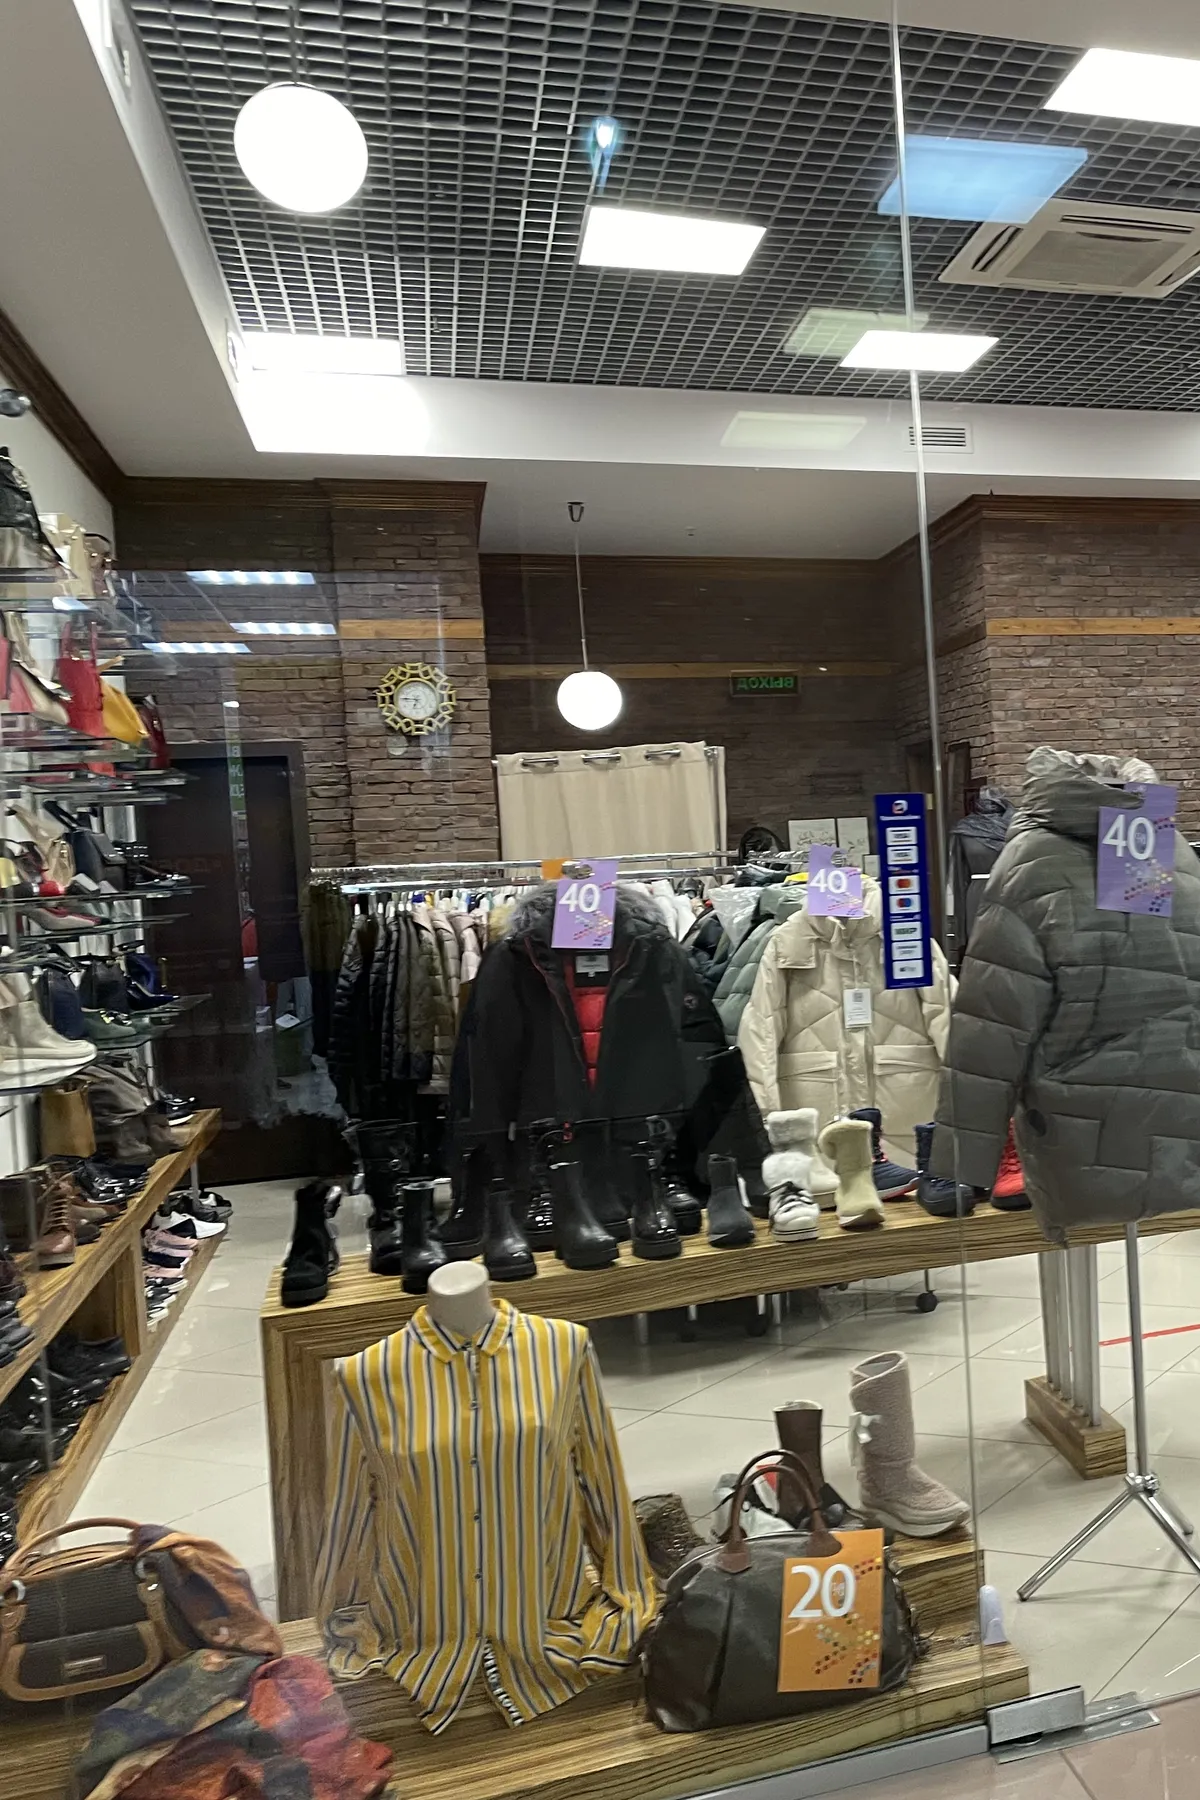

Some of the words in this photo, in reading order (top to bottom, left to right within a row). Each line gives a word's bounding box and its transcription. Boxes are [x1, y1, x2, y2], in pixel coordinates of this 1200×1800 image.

[1102, 814, 1155, 860] 40
[559, 883, 600, 913] 40
[809, 868, 848, 894] 40
[788, 1563, 856, 1618] 20
